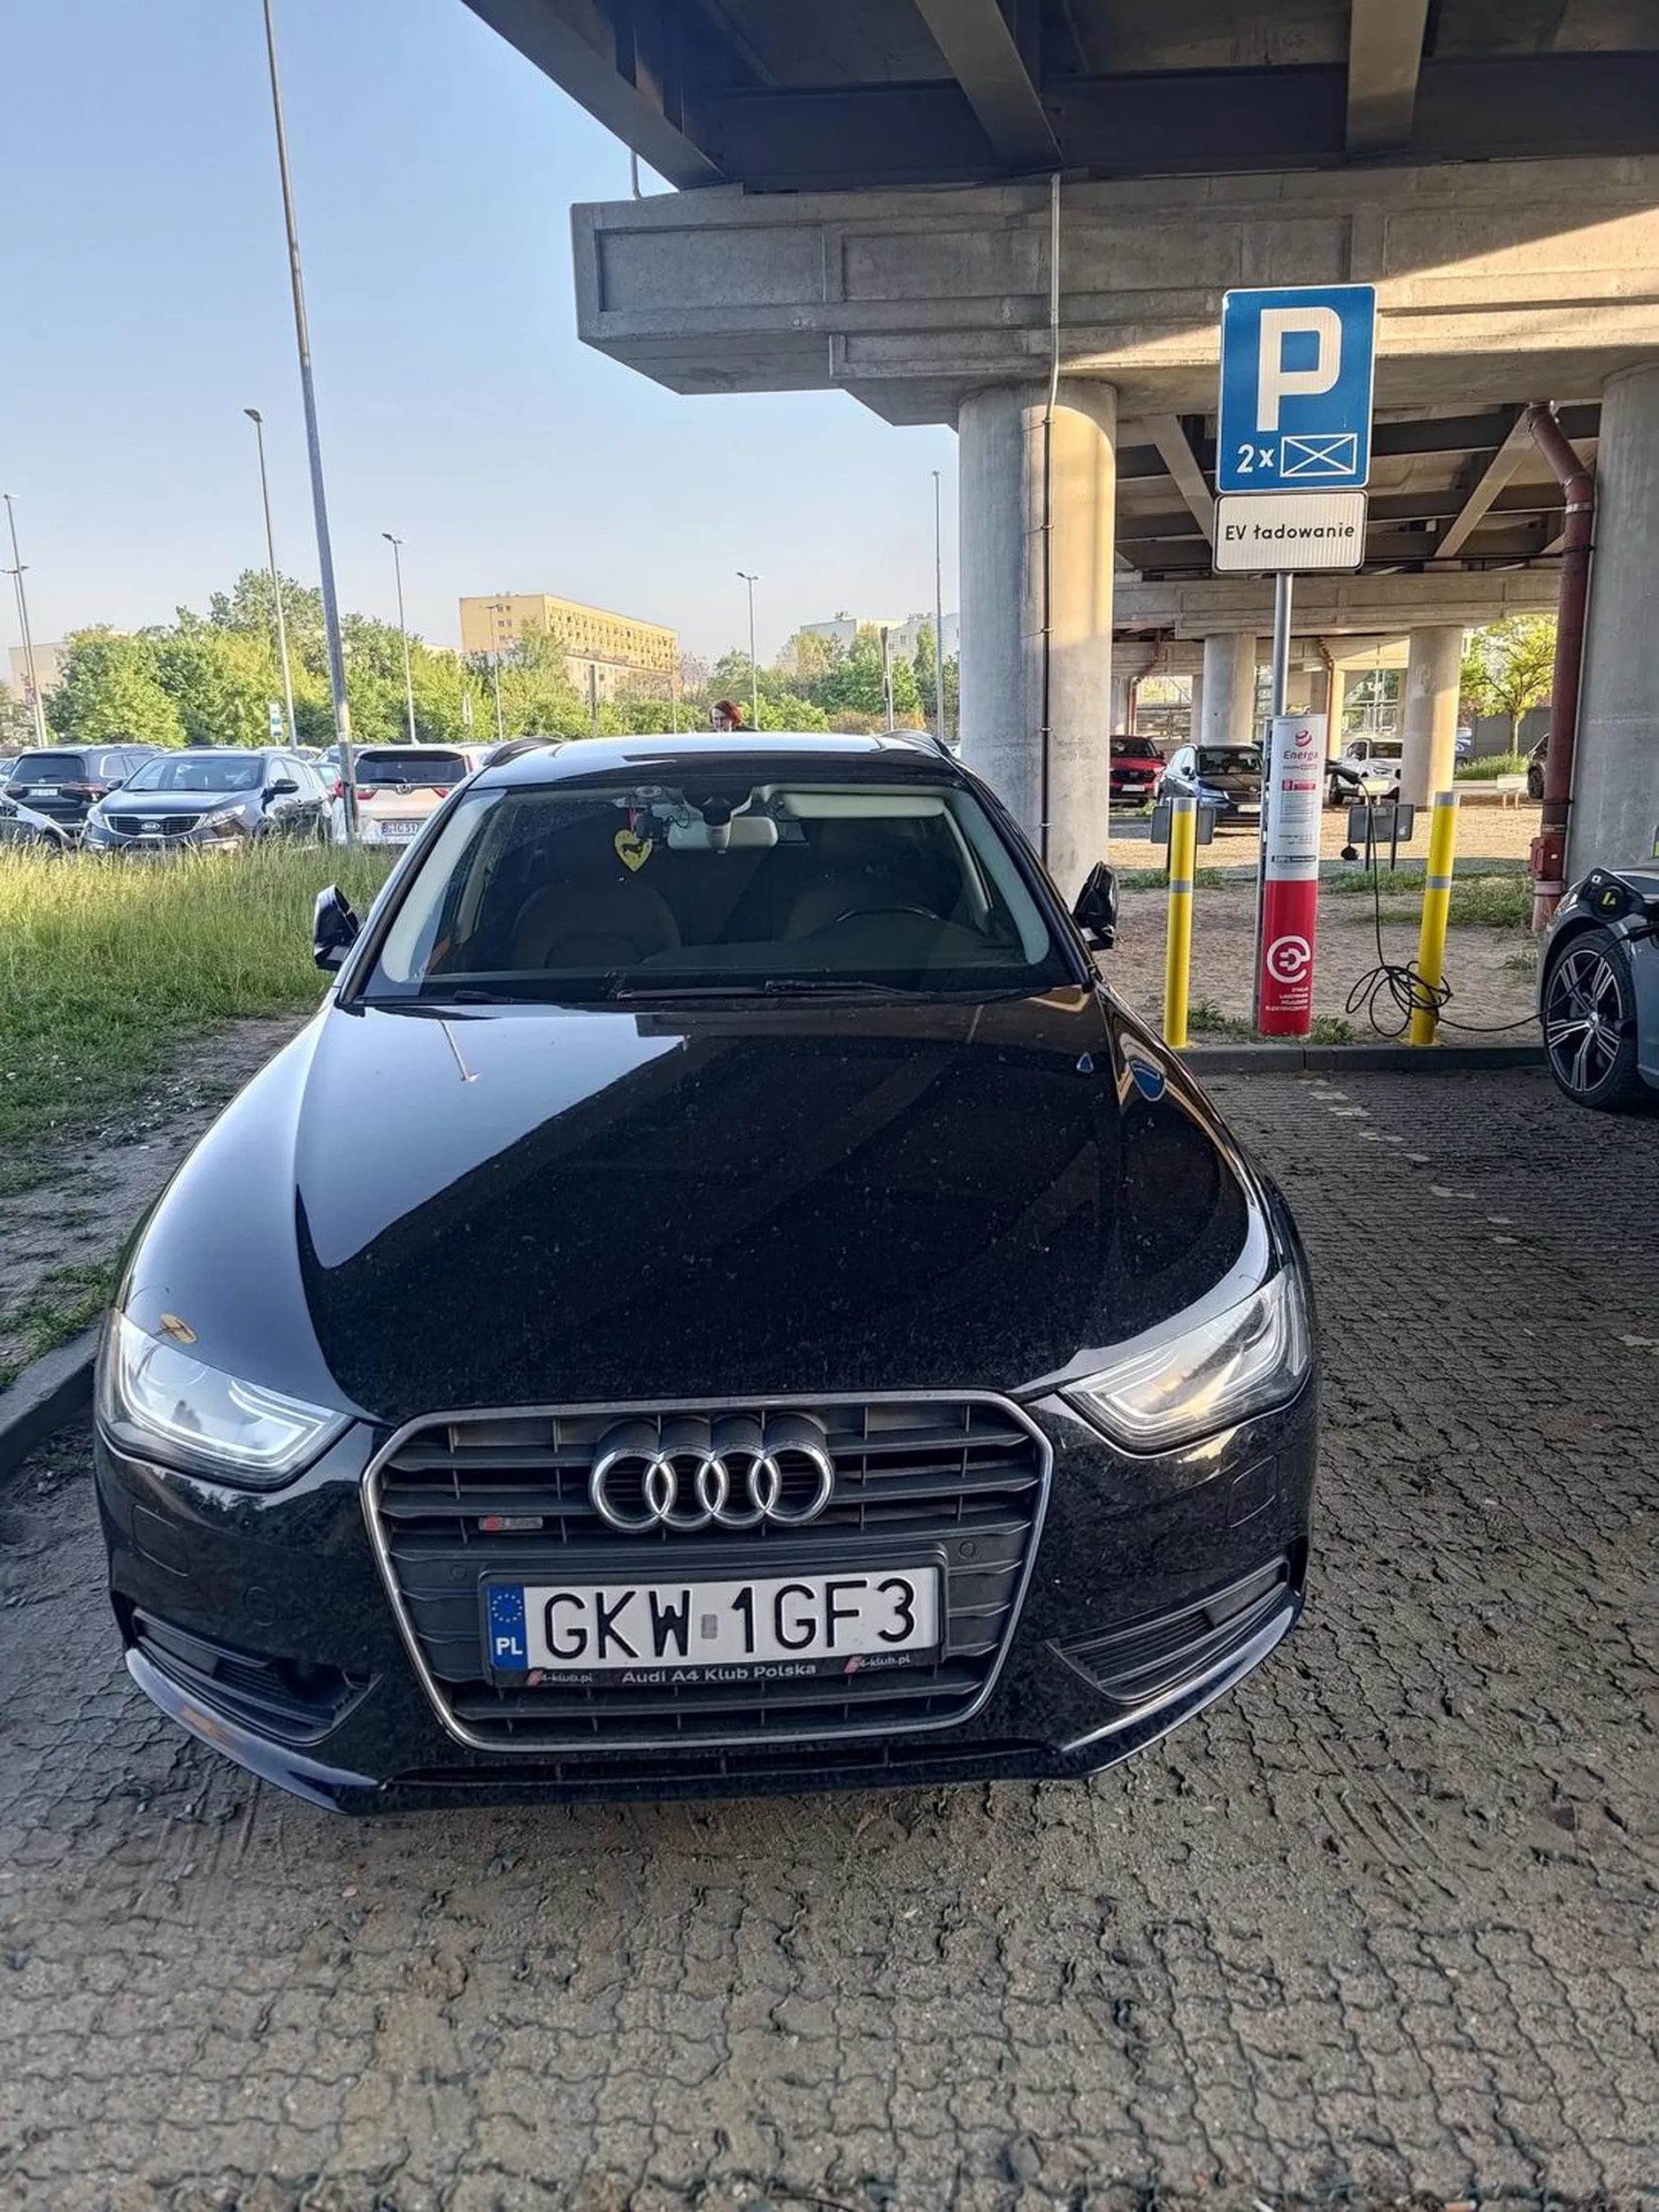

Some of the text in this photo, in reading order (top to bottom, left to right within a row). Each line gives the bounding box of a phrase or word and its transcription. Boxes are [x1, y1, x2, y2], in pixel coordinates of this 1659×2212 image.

[1256, 306, 1342, 432] P
[1225, 522, 1355, 541] EV ładowanie
[1283, 749, 1318, 762] Energa
[544, 1578, 916, 1661] GKW 1GF3
[495, 1637, 523, 1655] PL
[621, 1663, 818, 1684] Audi A4 Klub Polska
